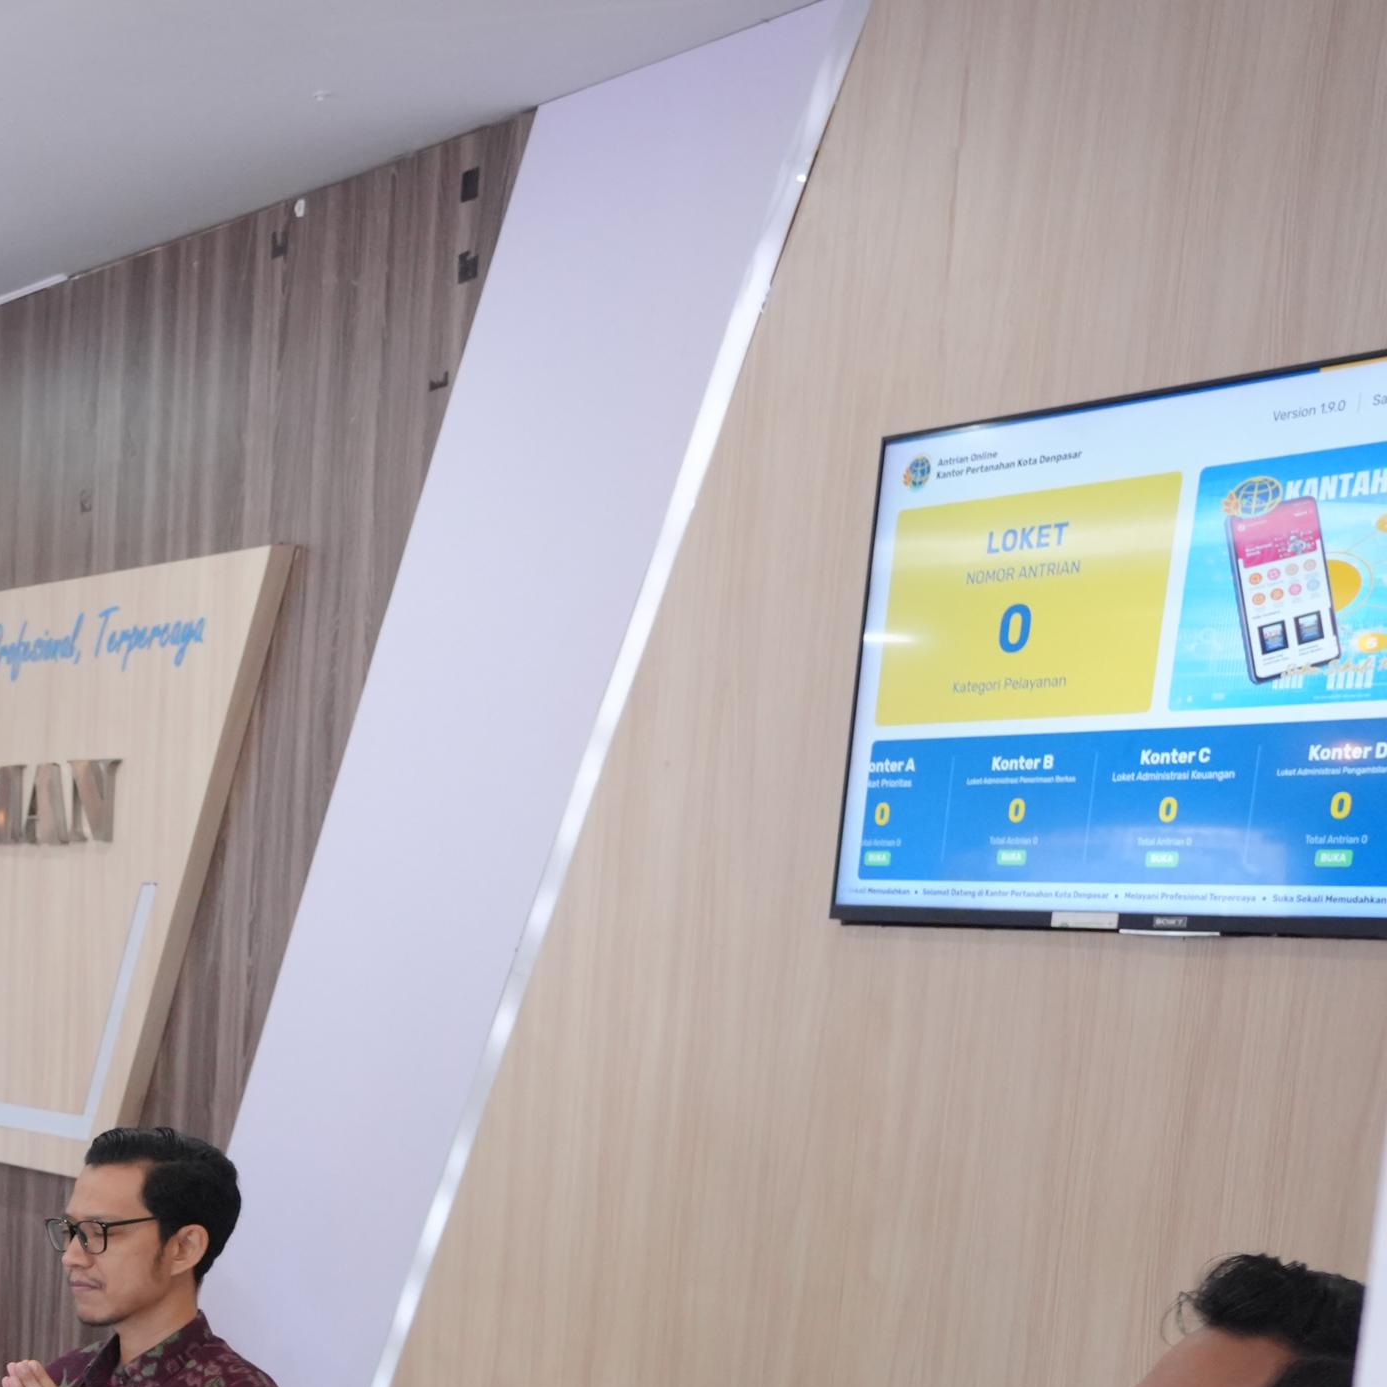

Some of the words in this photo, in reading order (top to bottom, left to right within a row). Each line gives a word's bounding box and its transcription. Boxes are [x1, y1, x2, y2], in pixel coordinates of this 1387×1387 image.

[1273, 406, 1316, 421] Version
[1321, 400, 1346, 414] 1.9.0
[936, 467, 964, 480] Kantor
[965, 461, 1016, 476] Pertanahan
[1017, 456, 1037, 468] Kota
[1039, 450, 1082, 466] Denpasar
[937, 454, 969, 467] Antrian
[970, 450, 998, 461] Online
[987, 522, 1069, 554] LOKET
[966, 565, 1015, 585] NOMOR
[1018, 560, 1081, 580] ANTRIAN
[998, 603, 1032, 653] 0
[952, 679, 1001, 696] Kategori
[1004, 675, 1067, 691] Pelayanan
[991, 755, 1039, 771] Konter
[1042, 754, 1054, 770] B
[1140, 749, 1196, 766] Konter
[1198, 747, 1211, 763] C
[1308, 743, 1372, 762] Konter
[868, 760, 903, 773] onter
[905, 758, 916, 772] A
[1112, 772, 1135, 782] Loket
[1136, 771, 1190, 782] Administrasi
[1191, 769, 1235, 782] Keuangan
[874, 802, 891, 826] 0
[1008, 798, 1026, 824] 0
[1158, 796, 1178, 823] 0
[1330, 791, 1352, 820] 0
[1305, 834, 1326, 845] Total
[1327, 834, 1359, 845] Antrian
[985, 889, 1009, 898] Kantor
[1124, 892, 1159, 902] Melayani
[1160, 892, 1208, 901] Profesional
[1209, 893, 1256, 904] Terpercaya
[1272, 894, 1294, 903] Suka
[1296, 894, 1324, 903] Sekali
[1325, 895, 1387, 905] Memudahkan
